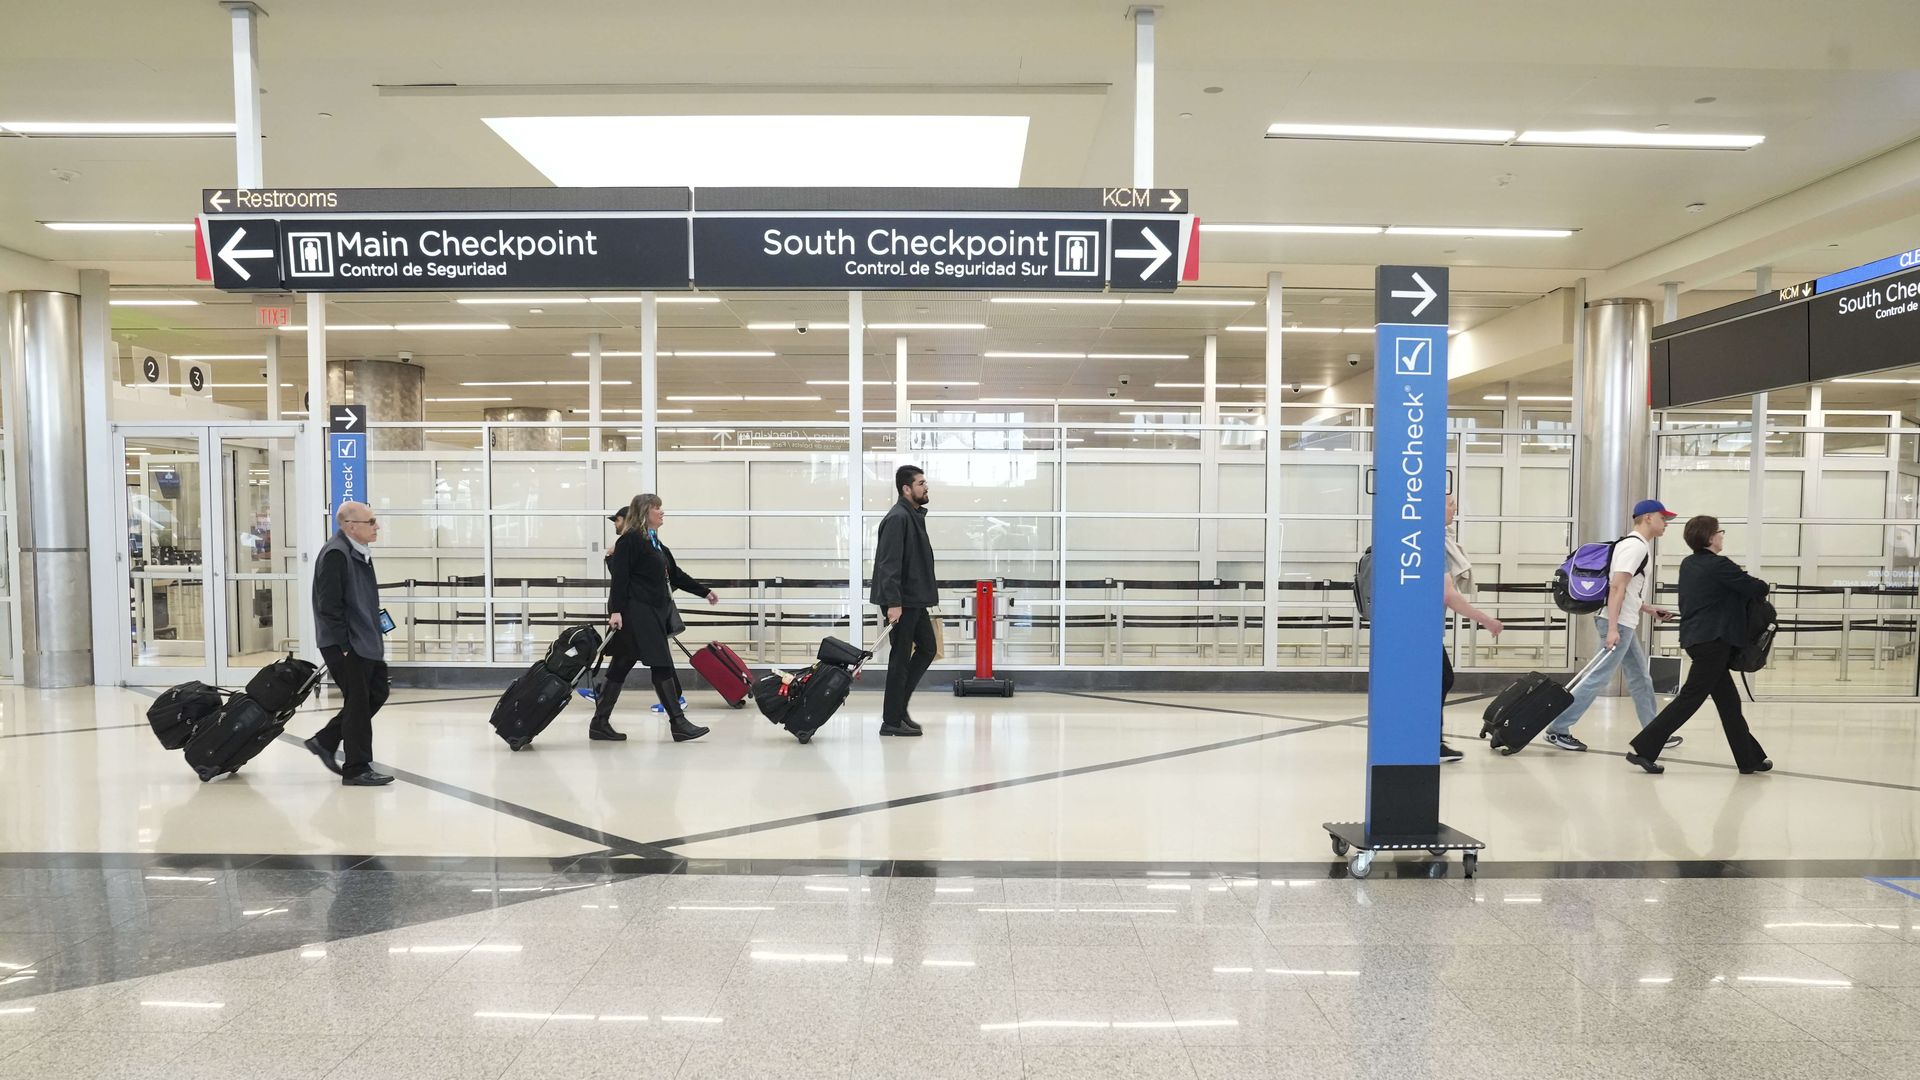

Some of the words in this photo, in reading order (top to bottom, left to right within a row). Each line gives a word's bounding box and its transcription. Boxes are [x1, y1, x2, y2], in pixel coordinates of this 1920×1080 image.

[235, 188, 338, 208] Restrooms
[1102, 187, 1151, 208] KCM
[337, 230, 409, 258] Main
[419, 229, 598, 260] Checkpoint
[763, 228, 856, 256] South
[867, 228, 1049, 259] Checkpoint
[339, 261, 398, 277] Control
[402, 261, 423, 277] de
[426, 261, 507, 279] Seguridad
[845, 260, 905, 276] Control
[909, 260, 930, 276] de
[934, 260, 1016, 278] Seguridad
[1020, 261, 1049, 276] Sur
[1779, 285, 1799, 302] KCM
[1838, 288, 1882, 315] South
[1885, 281, 1920, 303] Che
[1875, 302, 1905, 319] Control
[1907, 301, 1919, 312] de
[147, 361, 156, 378] 2
[193, 371, 201, 387] 3
[1400, 530, 1422, 585] TSA
